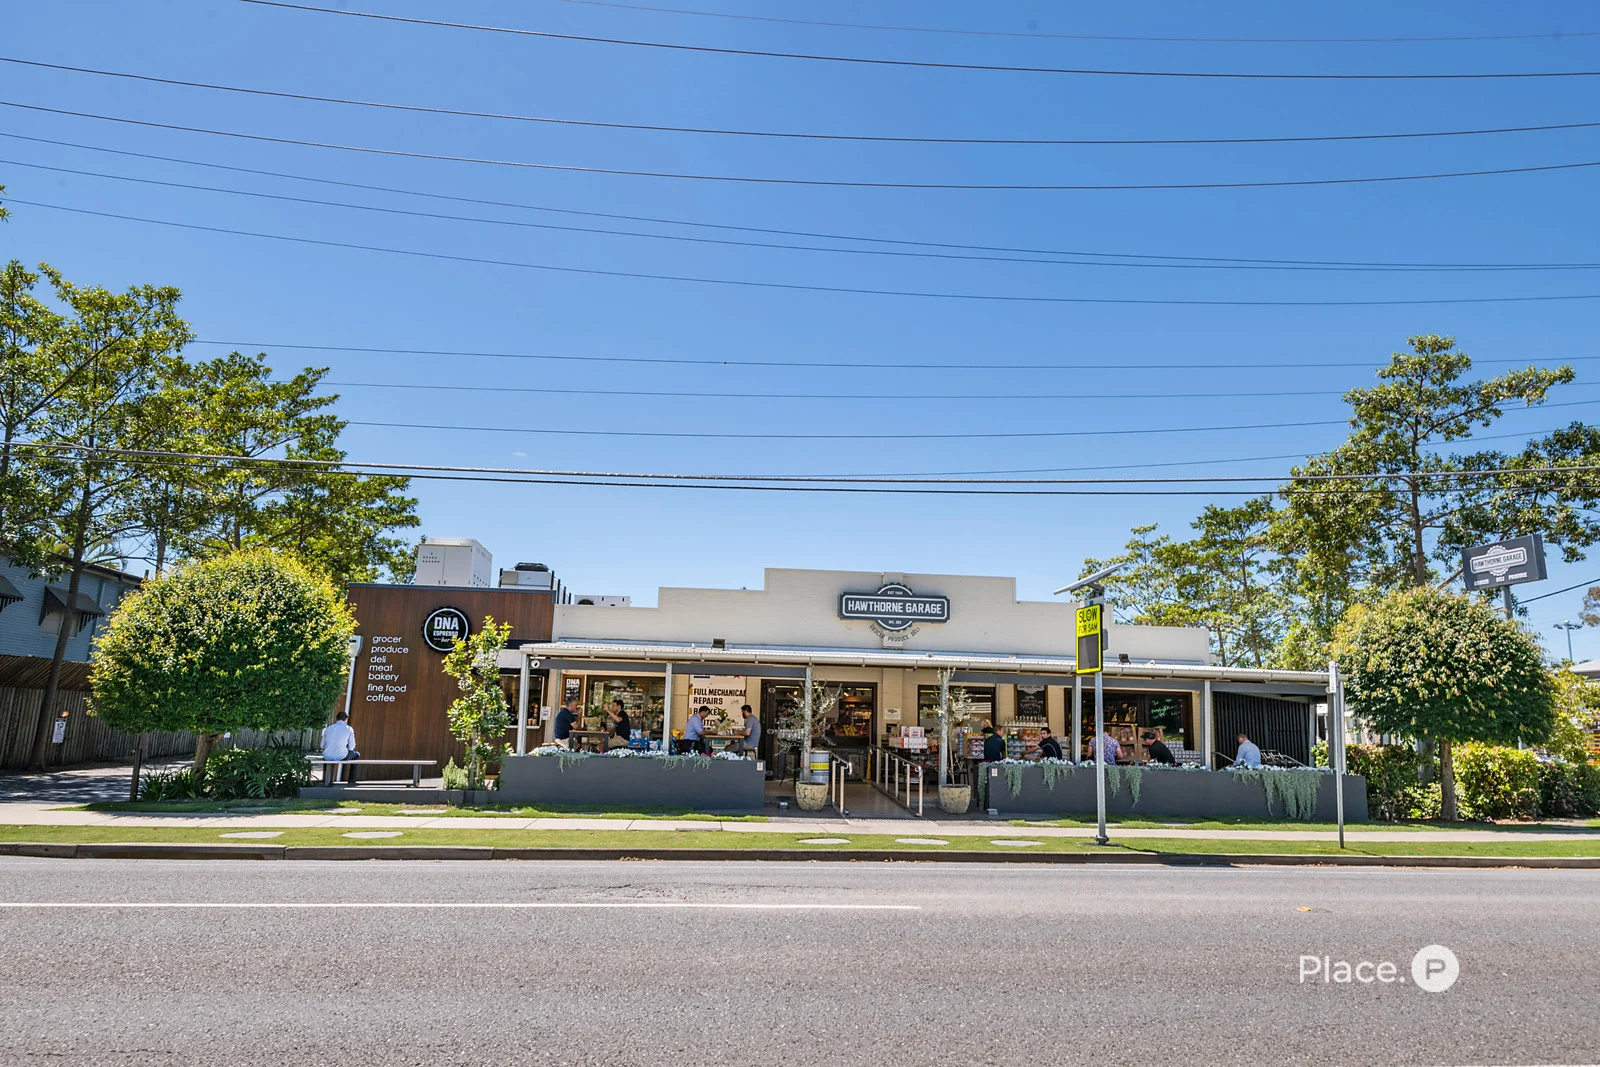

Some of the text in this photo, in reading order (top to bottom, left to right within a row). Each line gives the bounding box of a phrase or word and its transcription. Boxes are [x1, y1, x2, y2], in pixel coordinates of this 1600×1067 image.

[1502, 552, 1522, 562] GARAGE
[1508, 572, 1527, 580] PRODUCE
[848, 600, 942, 614] HAWTHORNE GARAGE
[1079, 608, 1097, 623] SLOW
[434, 616, 459, 630] DNA
[910, 626, 920, 637] DELI
[1079, 622, 1098, 634] FOR SAM
[371, 646, 409, 654] produce
[368, 673, 399, 681] bakery
[385, 684, 407, 692] food
[693, 688, 707, 696] FULL
[366, 694, 395, 702] coffee
[693, 697, 723, 705] REPAIRS
